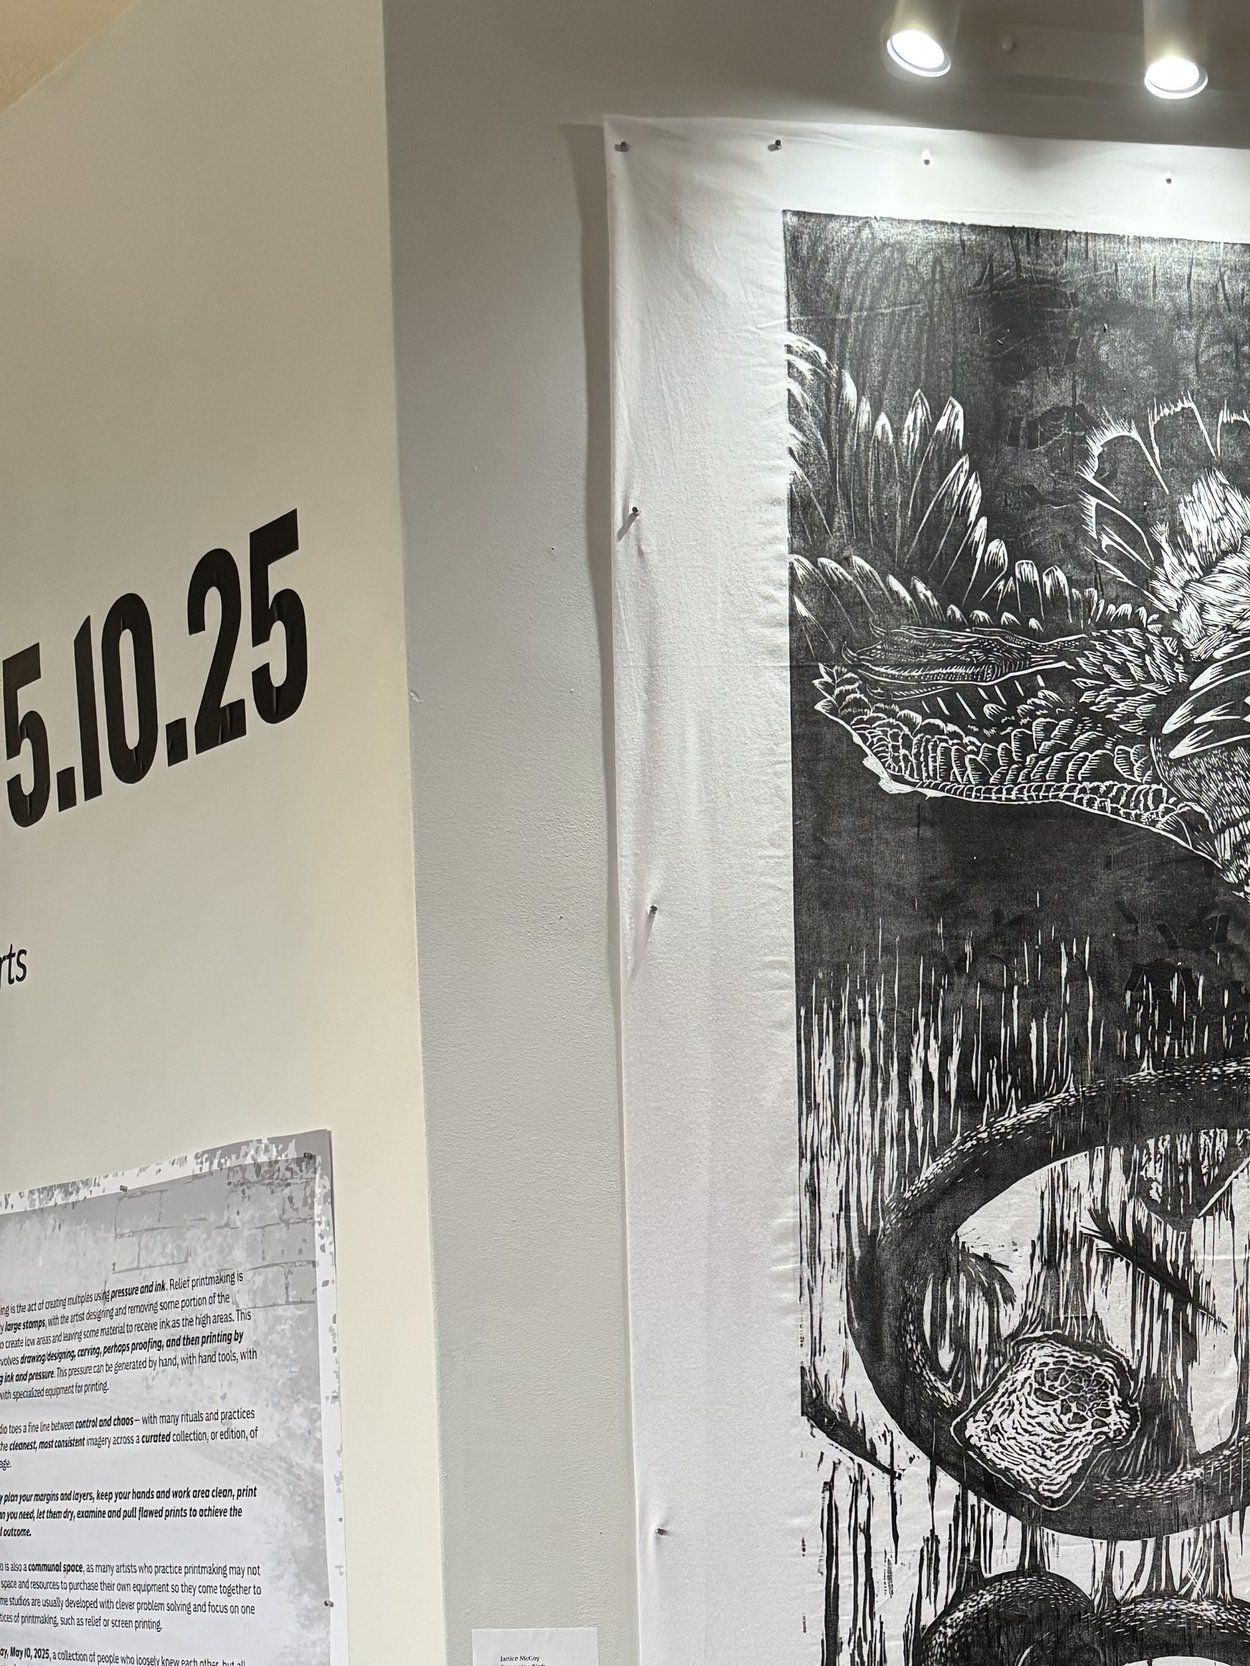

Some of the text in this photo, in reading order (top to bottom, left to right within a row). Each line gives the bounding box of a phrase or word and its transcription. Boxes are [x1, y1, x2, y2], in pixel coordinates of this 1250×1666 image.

[2, 508, 308, 828] 5.10.25
[111, 1271, 243, 1301] pressure Relief printmaking is
[180, 1294, 207, 1311] portion
[208, 1292, 216, 1305] of
[218, 1291, 230, 1304] the
[172, 1318, 180, 1329] as
[182, 1314, 193, 1328] the
[195, 1312, 211, 1328] high
[236, 1309, 251, 1322] This
[102, 1342, 130, 1357] perhaps
[182, 1334, 200, 1347] then
[201, 1331, 232, 1347] printing
[234, 1329, 244, 1344] by
[180, 1352, 197, 1366] with
[198, 1351, 216, 1365] hand
[240, 1348, 257, 1360] with
[75, 1407, 255, 1429] control rituals and practices
[54, 1436, 85, 1448] consistent
[211, 1431, 218, 1440] or
[250, 1426, 258, 1438] of
[33, 1490, 59, 1504] margins
[96, 1490, 113, 1503] keep
[132, 1488, 154, 1500] hands
[172, 1487, 191, 1499] work
[192, 1489, 210, 1498] area
[237, 1485, 257, 1500] print
[77, 1505, 242, 1521] examine pull flawed prints to achieve the
[28, 1561, 62, 1572] communal
[184, 1563, 227, 1578] printmaking
[229, 1566, 245, 1578] may
[247, 1565, 260, 1576] not
[171, 1582, 262, 1597] so they come together to
[192, 1601, 255, 1614] and focus on one
[10, 1646, 23, 1660] May
